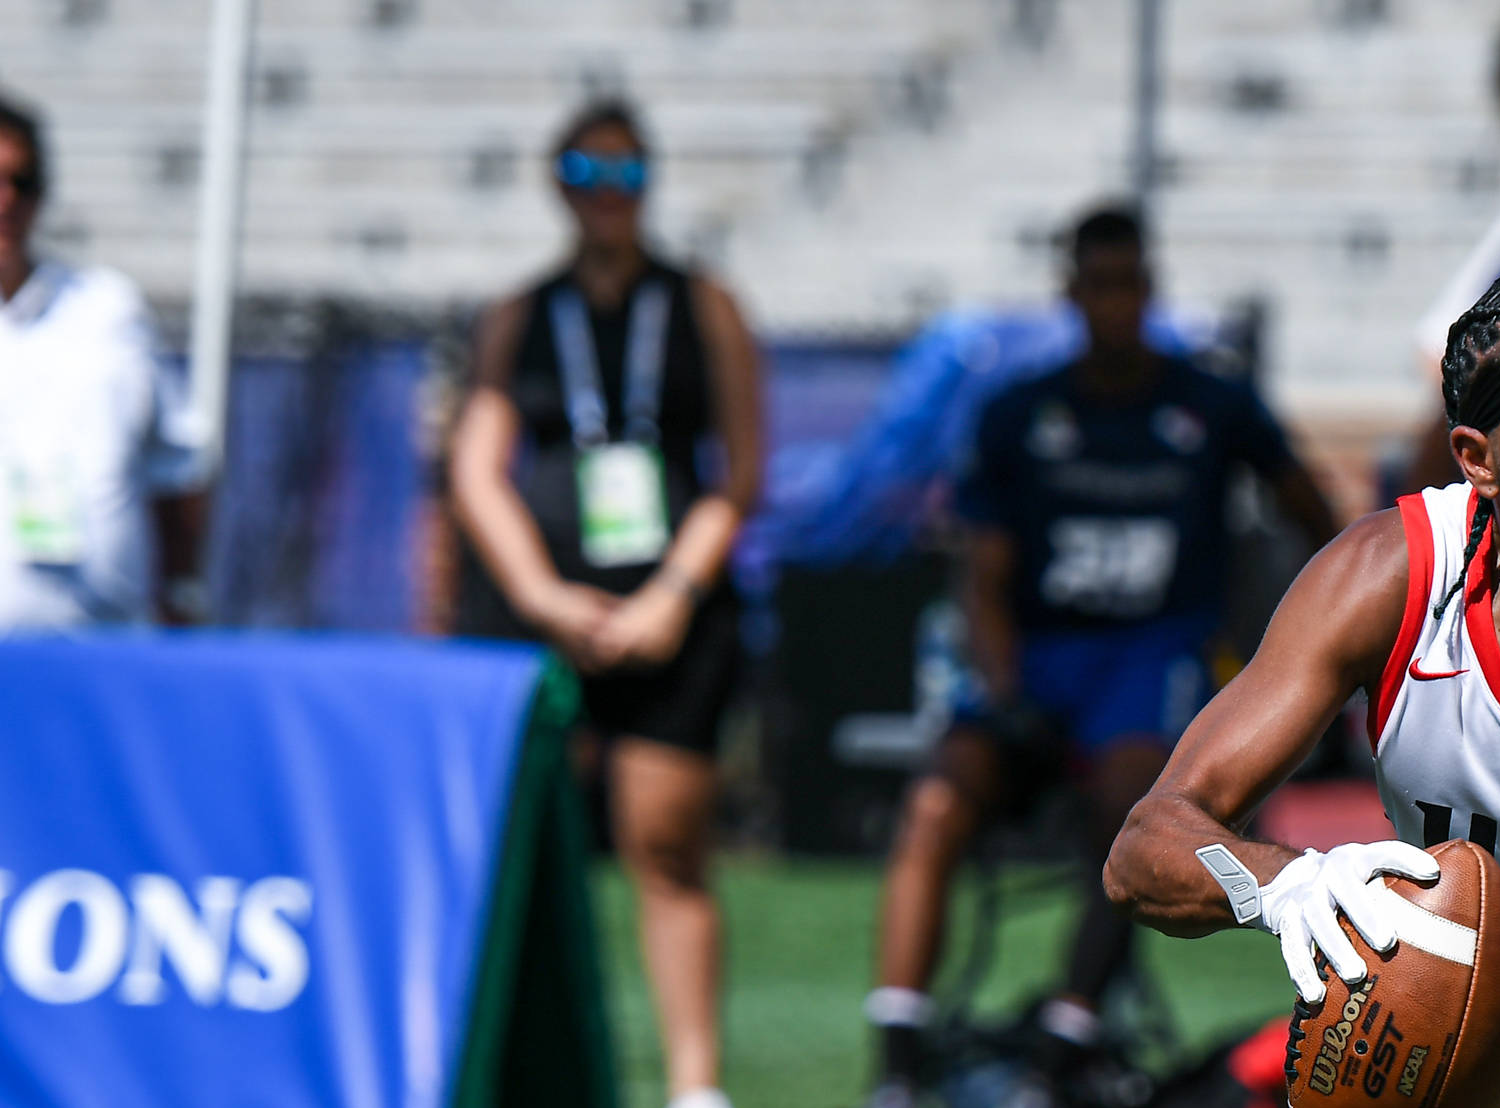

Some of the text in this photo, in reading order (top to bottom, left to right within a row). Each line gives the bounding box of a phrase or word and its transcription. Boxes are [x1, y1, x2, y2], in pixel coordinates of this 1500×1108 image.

[0, 867, 313, 1013] ONS
[1363, 1011, 1404, 1099] GST
[1397, 1045, 1430, 1097] NCAA
